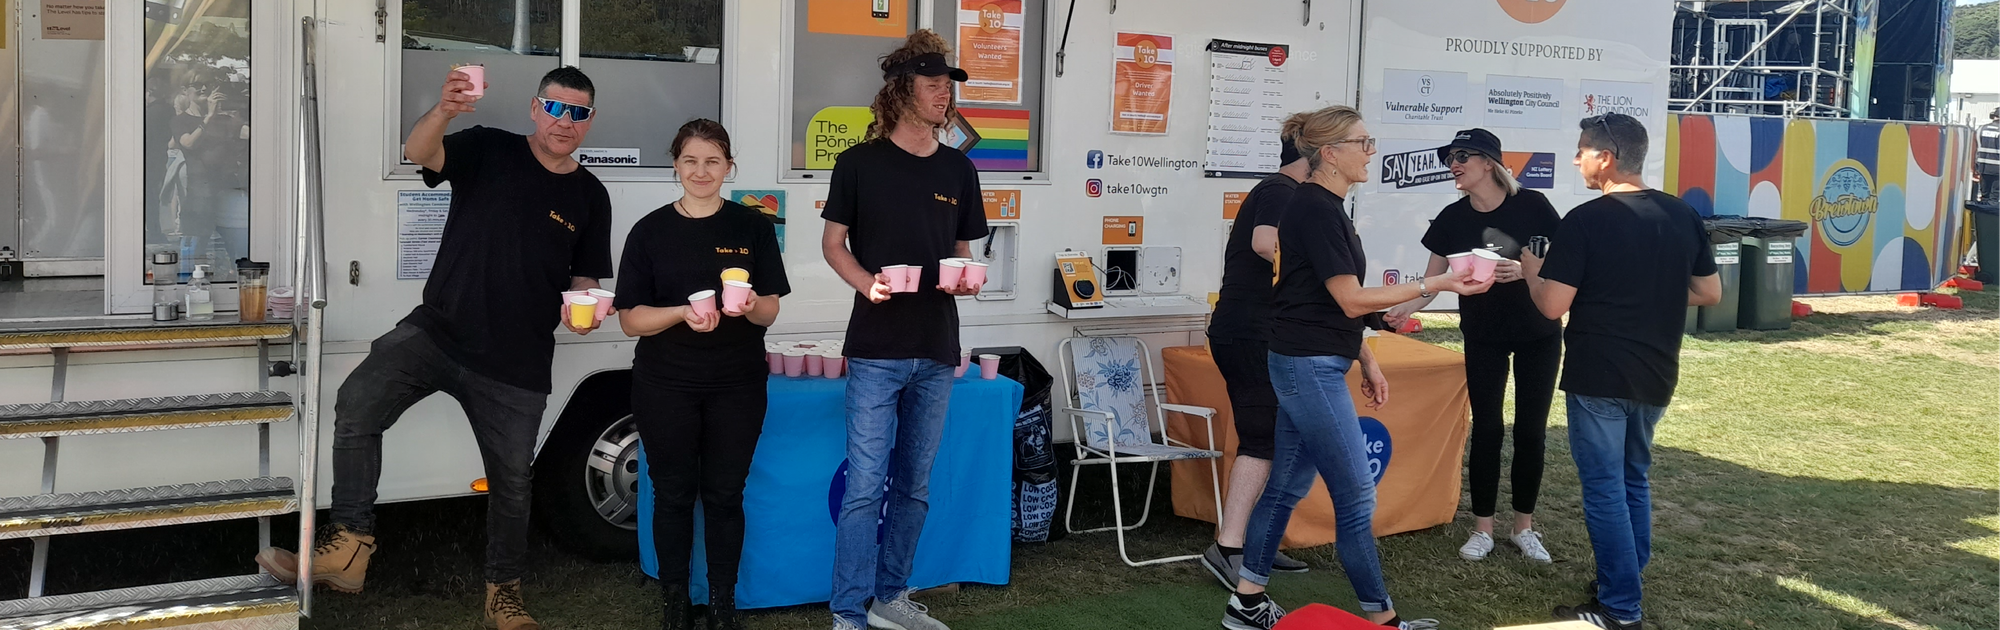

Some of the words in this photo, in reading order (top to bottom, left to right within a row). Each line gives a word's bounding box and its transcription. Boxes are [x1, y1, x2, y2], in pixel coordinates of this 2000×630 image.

[982, 9, 1001, 19] Take
[989, 19, 1001, 29] 10
[972, 42, 1008, 51] Volunteers
[1137, 45, 1156, 55] Take
[1233, 43, 1255, 52] midnight
[1445, 37, 1509, 55] PROUDLY
[1511, 42, 1586, 61] SUPPORTED
[1587, 47, 1604, 62] BY
[977, 52, 1002, 60] Wanted
[1143, 54, 1155, 64] 10
[1421, 78, 1431, 86] VS
[1420, 86, 1431, 94] CT
[1488, 88, 1522, 99] Absolutely
[1523, 90, 1552, 101] Positively
[1488, 96, 1524, 107] Wellington
[1525, 99, 1536, 108] City
[1537, 99, 1560, 108] Council
[1597, 94, 1611, 105] THE
[1612, 95, 1633, 106] LION
[1385, 101, 1430, 113] Vulnerable
[1430, 103, 1463, 116] Support
[1596, 105, 1649, 117] FOUNDATION
[815, 120, 848, 134] The
[579, 153, 637, 164] Panasonic
[1107, 154, 1198, 171] Take10Wellington
[1107, 183, 1168, 198] take10wgtn
[933, 192, 948, 202] Take
[950, 197, 958, 205] 10
[1809, 193, 1879, 222] Brewtown
[548, 209, 564, 224] Take
[567, 222, 576, 232] 10
[739, 247, 749, 255] 10
[1363, 433, 1384, 454] ke
[1041, 481, 1056, 495] COST
[1023, 494, 1039, 504] LOW
